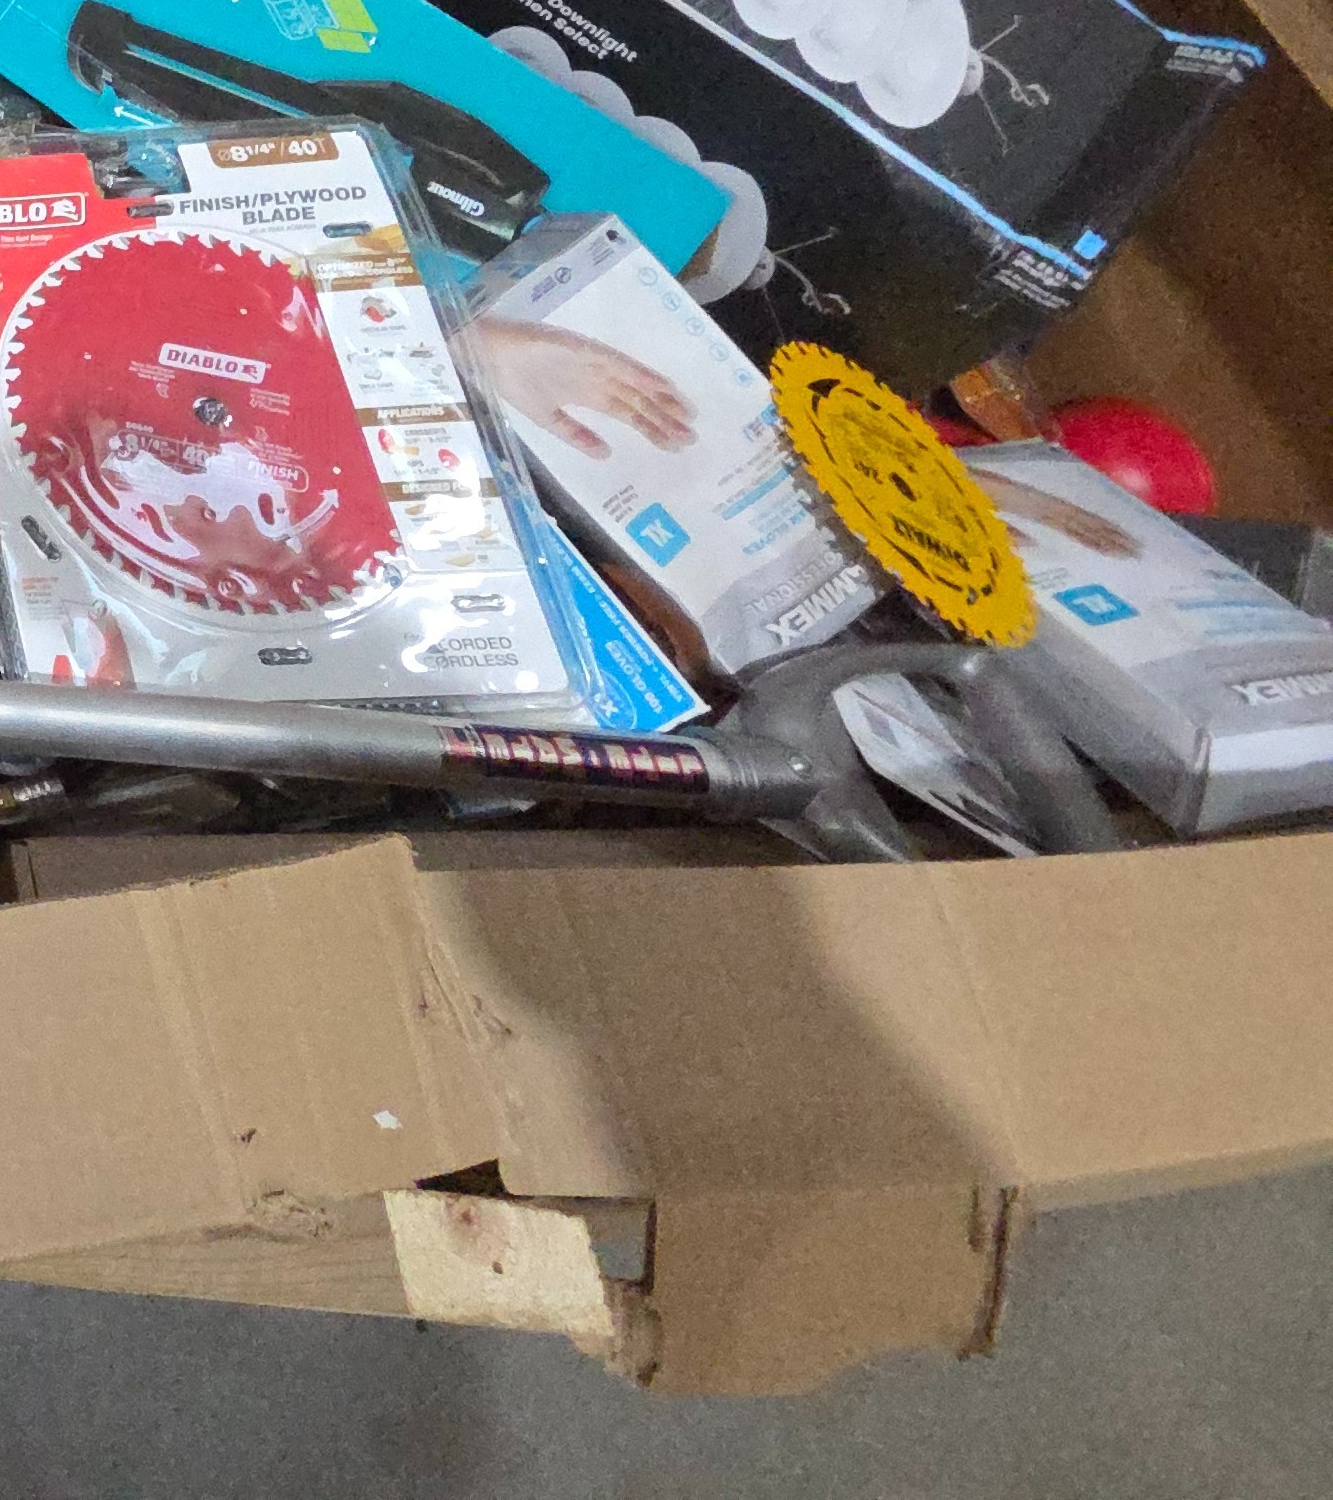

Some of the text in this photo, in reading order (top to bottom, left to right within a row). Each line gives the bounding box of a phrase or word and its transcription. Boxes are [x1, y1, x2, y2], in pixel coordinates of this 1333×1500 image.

[552, 17, 609, 61] Select
[178, 186, 367, 215] FINISH/PLYWOOD
[426, 180, 485, 217] Gilmour
[242, 205, 317, 226] BLADE
[166, 348, 239, 375] DIABLO
[376, 405, 445, 419] APPLICATIONS
[246, 459, 300, 482] FINISH
[640, 518, 677, 547] XL
[750, 549, 844, 613] OFESSIONAL
[436, 636, 513, 652] CORDED
[604, 639, 647, 693] GLOVES
